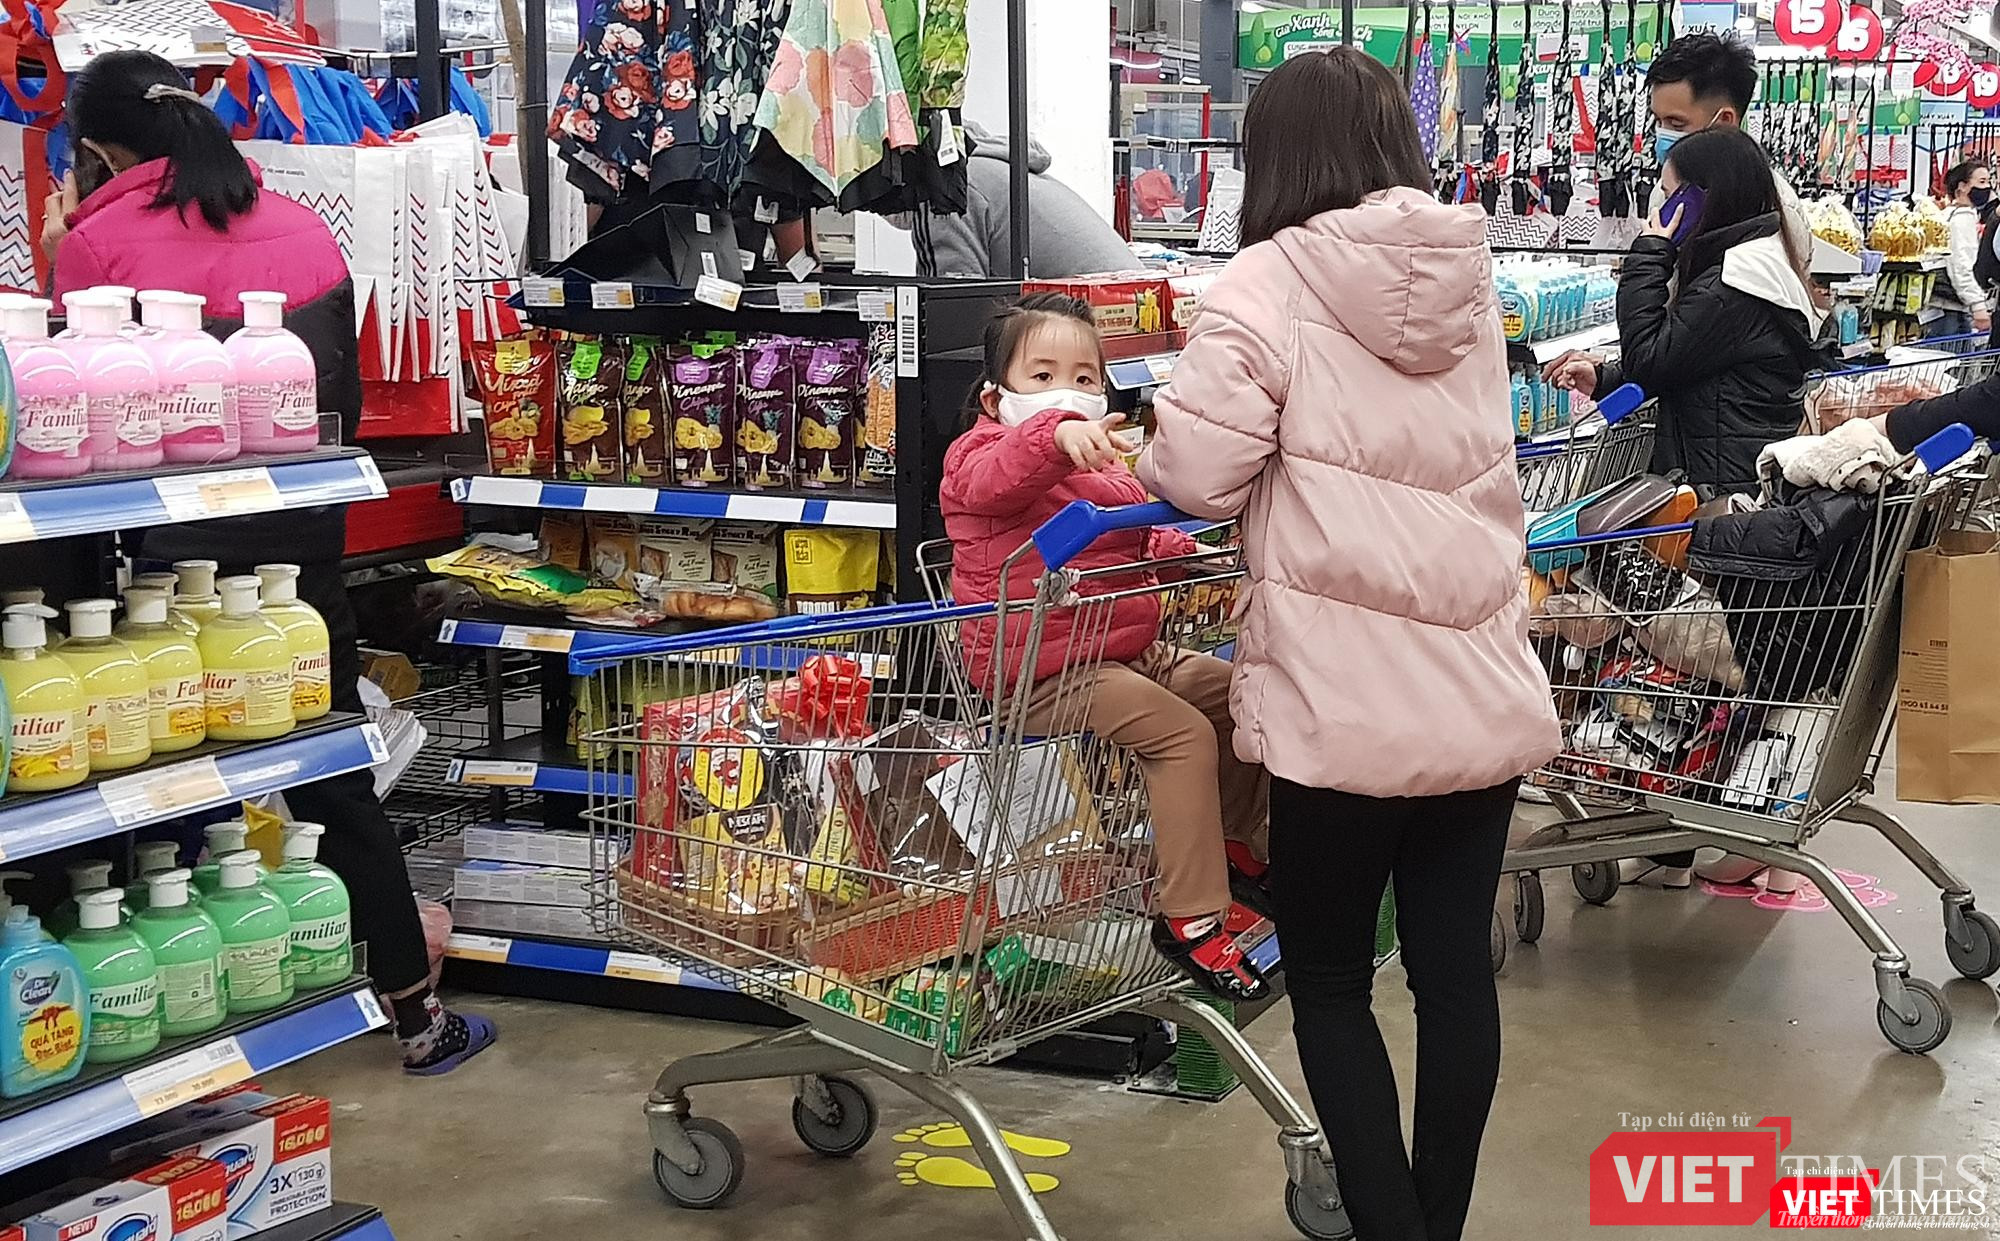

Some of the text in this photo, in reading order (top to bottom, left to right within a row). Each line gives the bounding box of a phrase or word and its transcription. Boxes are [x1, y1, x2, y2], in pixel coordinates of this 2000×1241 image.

[1292, 13, 1331, 32] Xanh
[1787, 0, 1825, 35] 15
[1335, 22, 1373, 41] Sch
[1836, 18, 1870, 51] 16
[1971, 71, 1999, 97] 19
[21, 986, 52, 1001] Clean
[270, 1189, 327, 1217] PROTECTION
